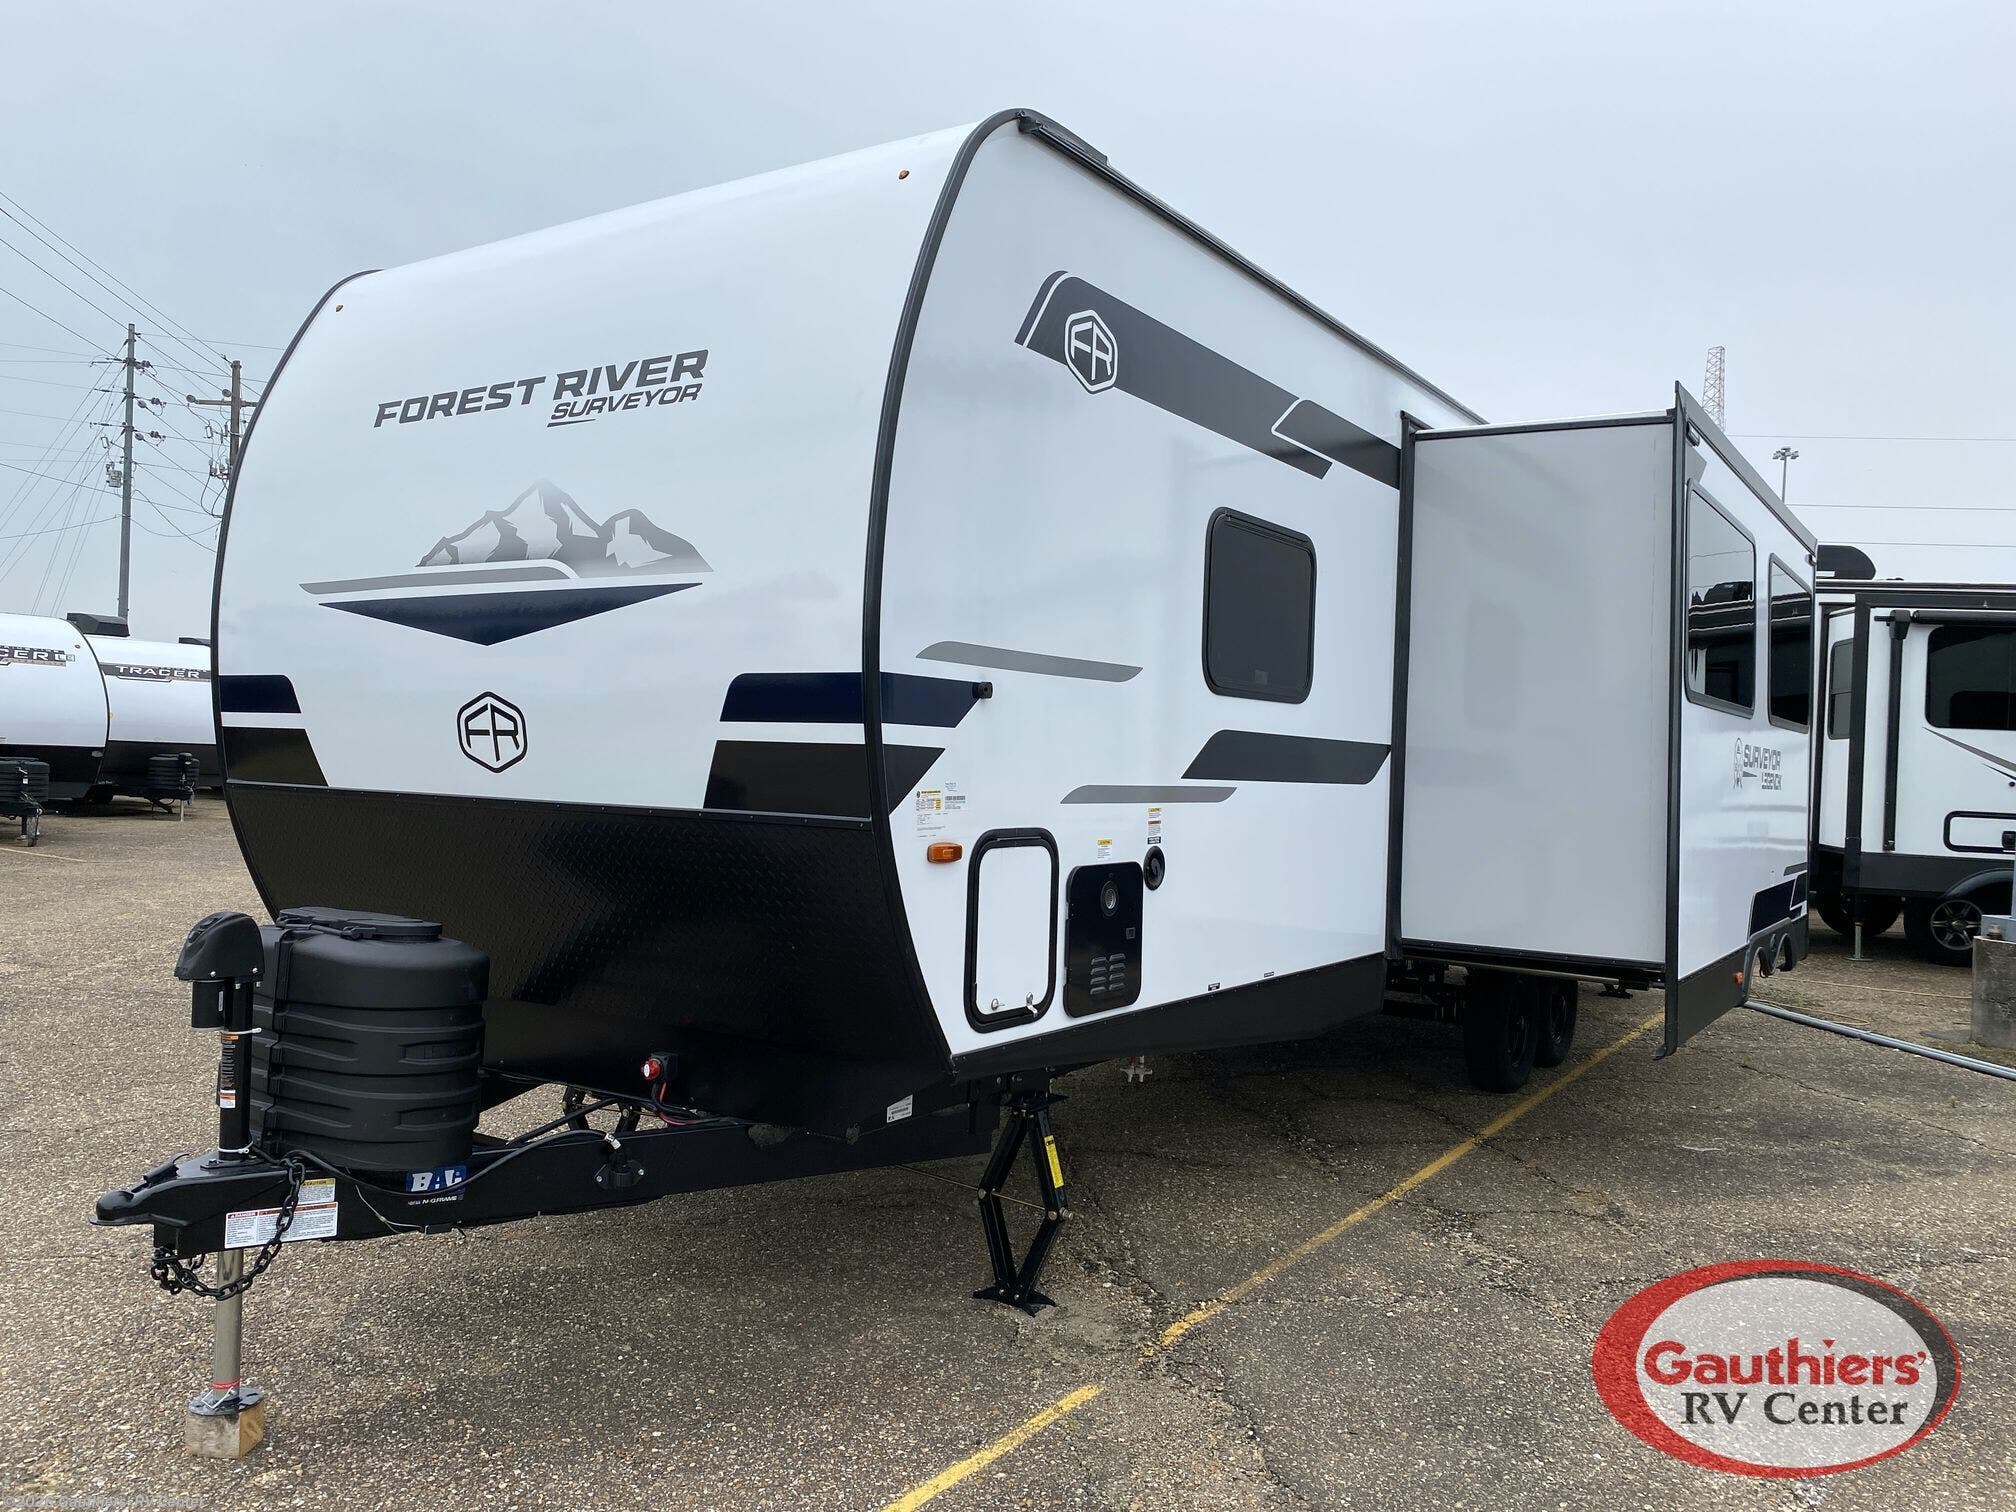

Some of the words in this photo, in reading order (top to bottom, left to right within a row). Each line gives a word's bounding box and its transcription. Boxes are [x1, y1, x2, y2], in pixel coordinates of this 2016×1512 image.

[374, 376, 547, 428] FOREST
[553, 349, 709, 401] RIVER
[550, 383, 702, 421] SURVEYOR
[115, 665, 200, 679] TRACER
[1743, 744, 1782, 771] SURVEYOR
